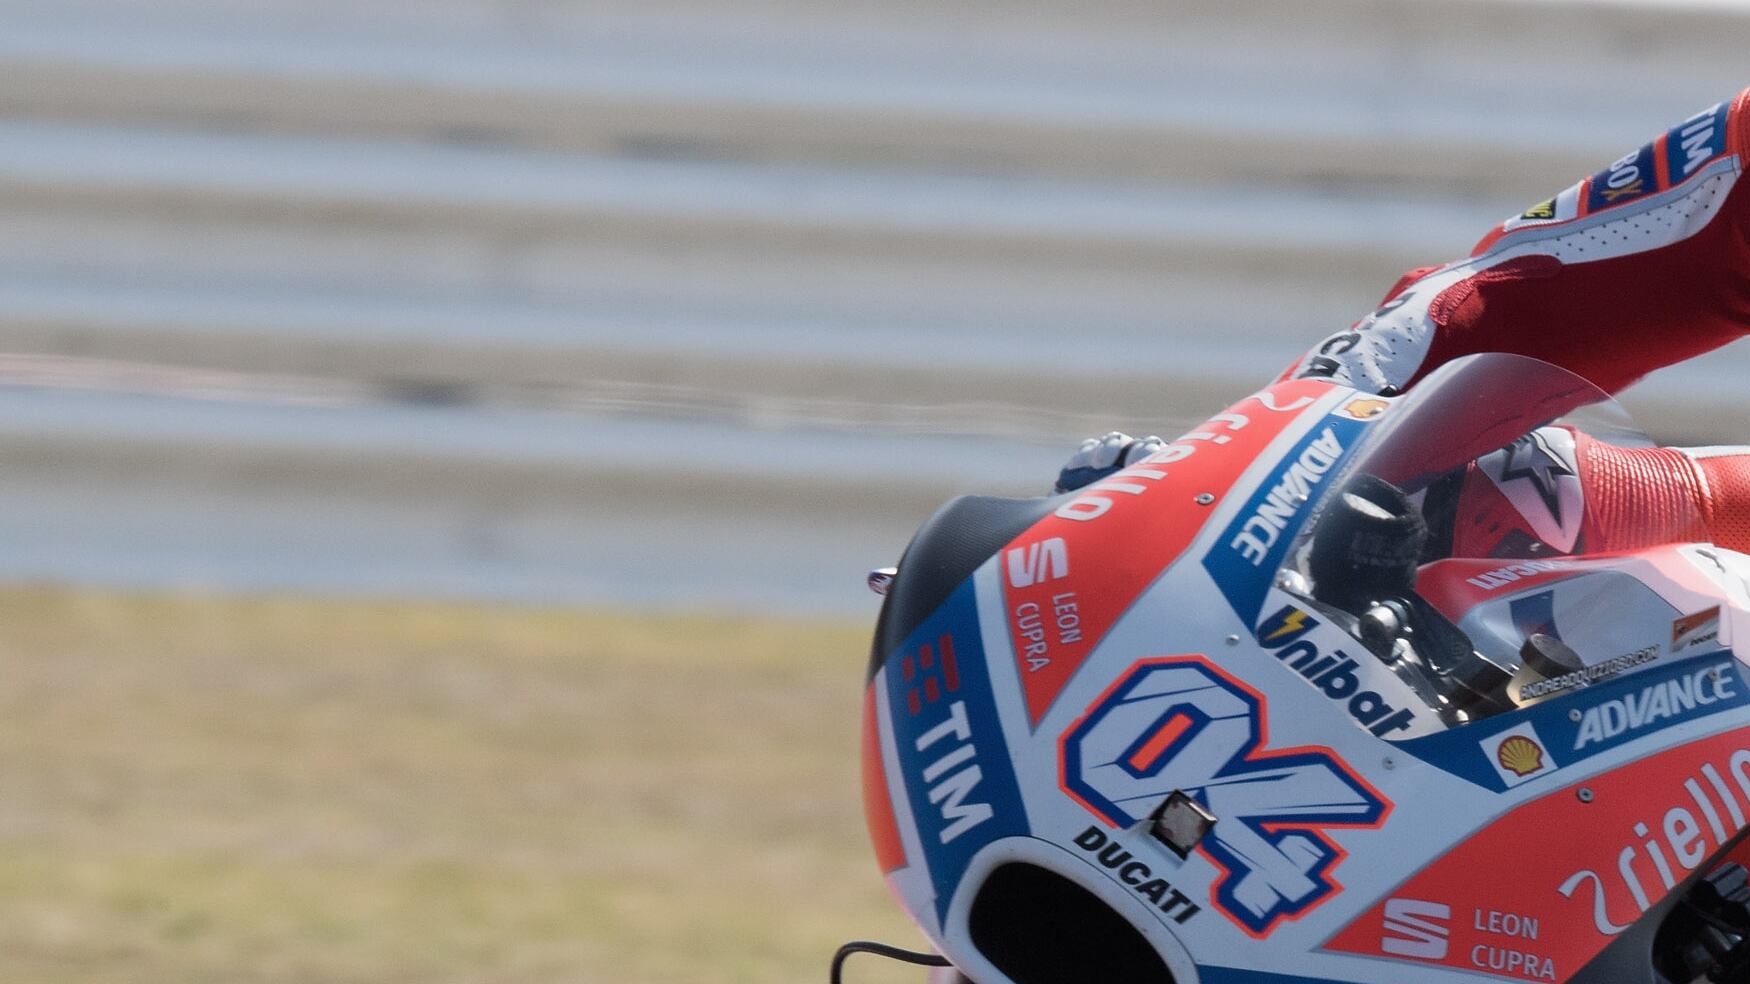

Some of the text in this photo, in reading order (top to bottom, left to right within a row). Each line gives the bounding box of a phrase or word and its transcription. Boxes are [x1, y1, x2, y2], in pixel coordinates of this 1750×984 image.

[1230, 427, 1345, 568] ADVANCE
[1015, 602, 1050, 673] CUPRA
[1052, 592, 1083, 645] LEON
[1257, 604, 1416, 738] Unibat
[1574, 661, 1737, 751] ADVANCE
[914, 700, 994, 845] TIM
[1056, 653, 1396, 940] 04
[1073, 825, 1203, 926] DUCATI
[1470, 944, 1556, 983] CUPRA
[1473, 907, 1539, 941] LEON
